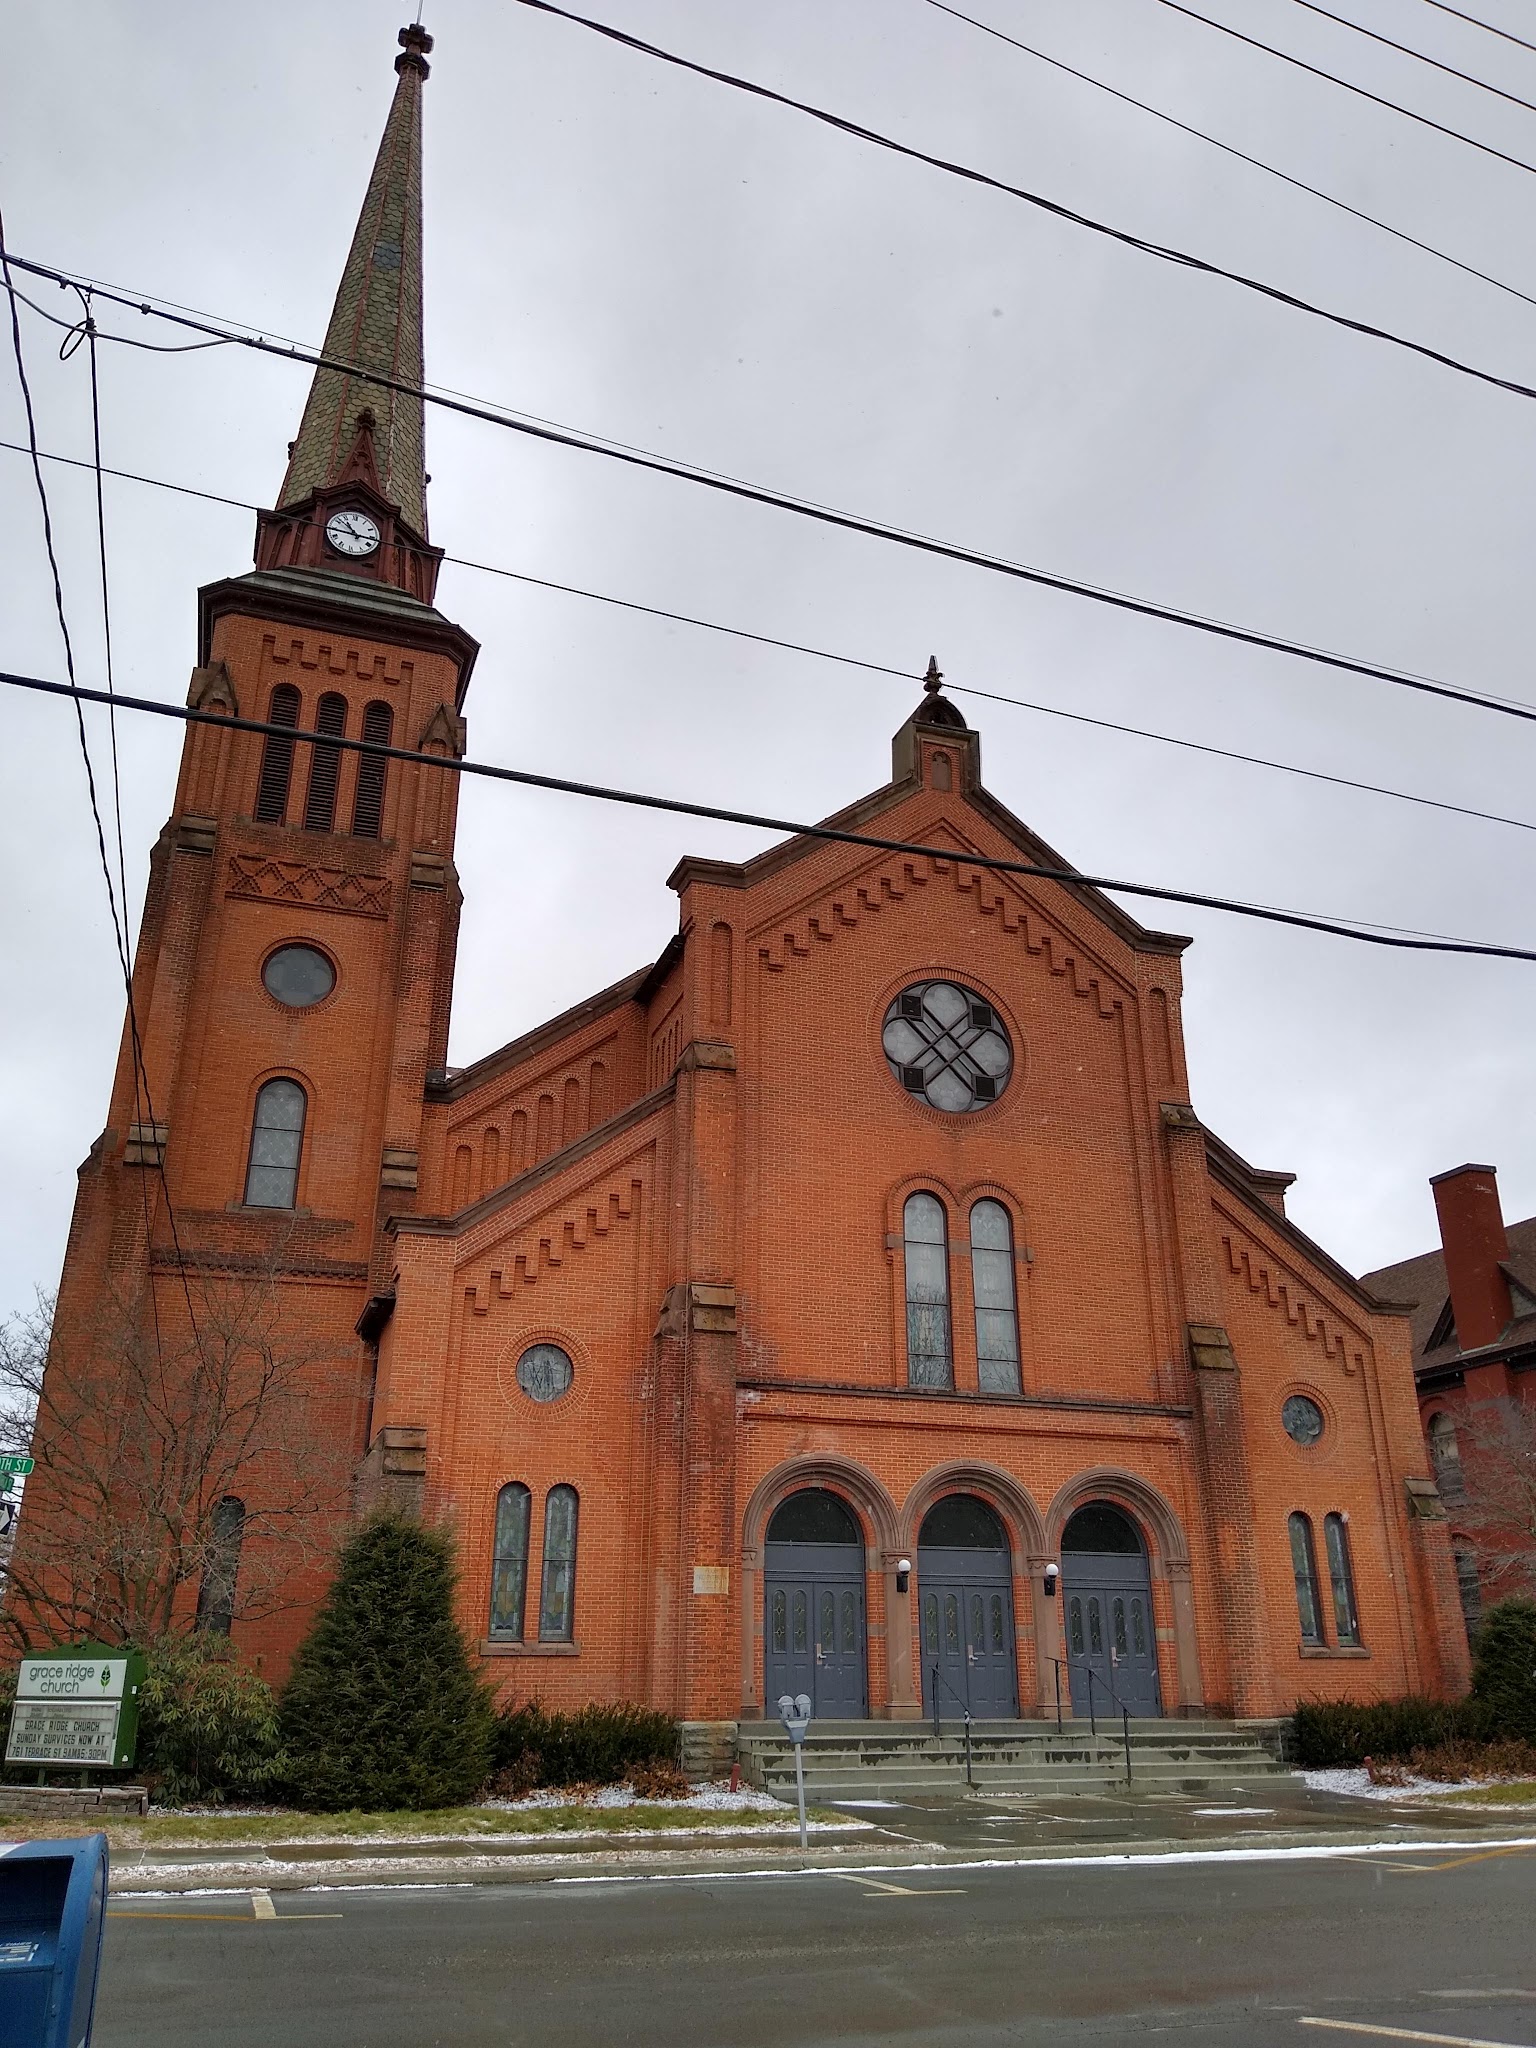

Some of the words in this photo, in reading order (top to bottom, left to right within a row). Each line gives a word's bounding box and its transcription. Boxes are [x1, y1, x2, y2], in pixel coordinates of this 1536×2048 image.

[0, 1458, 13, 1470] TH
[14, 1459, 27, 1472] ST
[30, 1666, 63, 1681] grace
[65, 1664, 95, 1682] ridge
[40, 1679, 79, 1693] church
[25, 1720, 46, 1731] GRACE
[49, 1721, 69, 1731] RIDGE
[73, 1721, 100, 1732] CHURCH
[16, 1733, 41, 1743] SUNDAY
[78, 1735, 93, 1745] NOW
[95, 1735, 105, 1745] AT
[11, 1746, 23, 1757] 761
[25, 1747, 52, 1758] TERRACE
